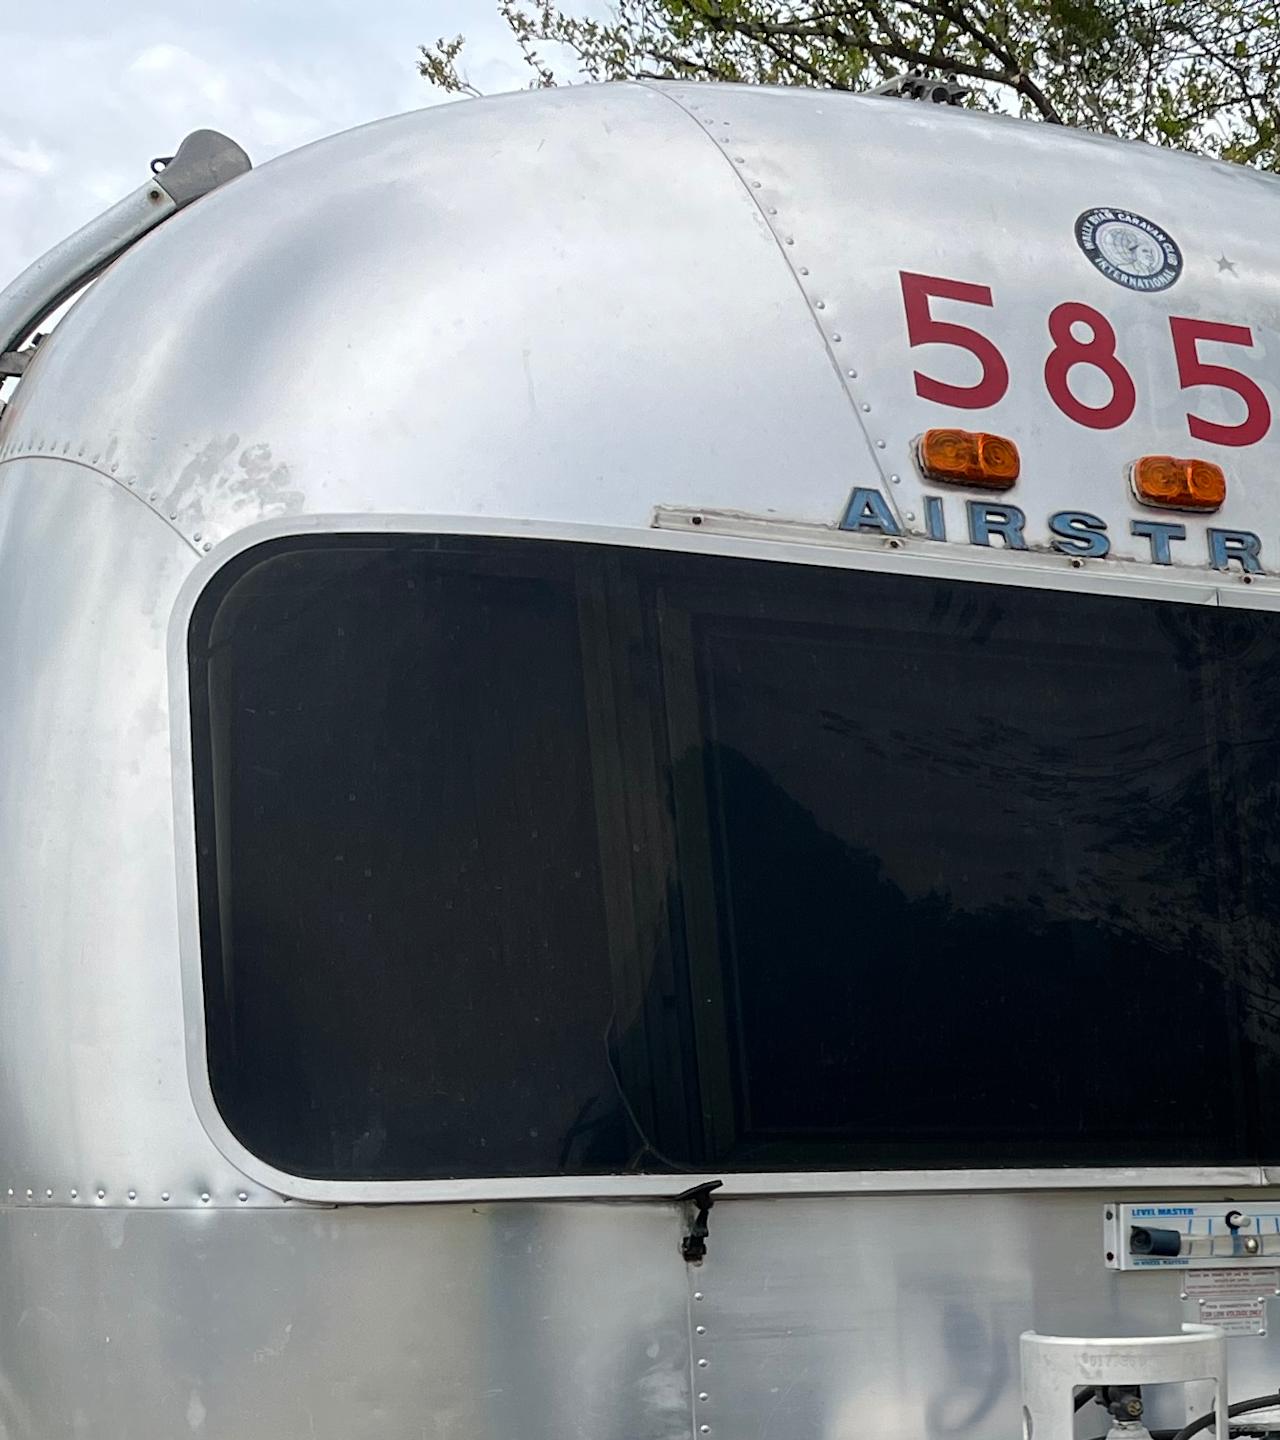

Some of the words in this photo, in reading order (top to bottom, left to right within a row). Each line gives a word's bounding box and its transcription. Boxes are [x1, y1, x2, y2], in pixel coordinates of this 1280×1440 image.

[1081, 222, 1095, 250] WALLY
[1089, 211, 1115, 226] BYAM
[1117, 213, 1167, 242] CARAVAN
[1162, 242, 1178, 267] CLUB
[1095, 257, 1177, 289] INTERNATIONAL
[1132, 1208, 1156, 1216] LEVEL
